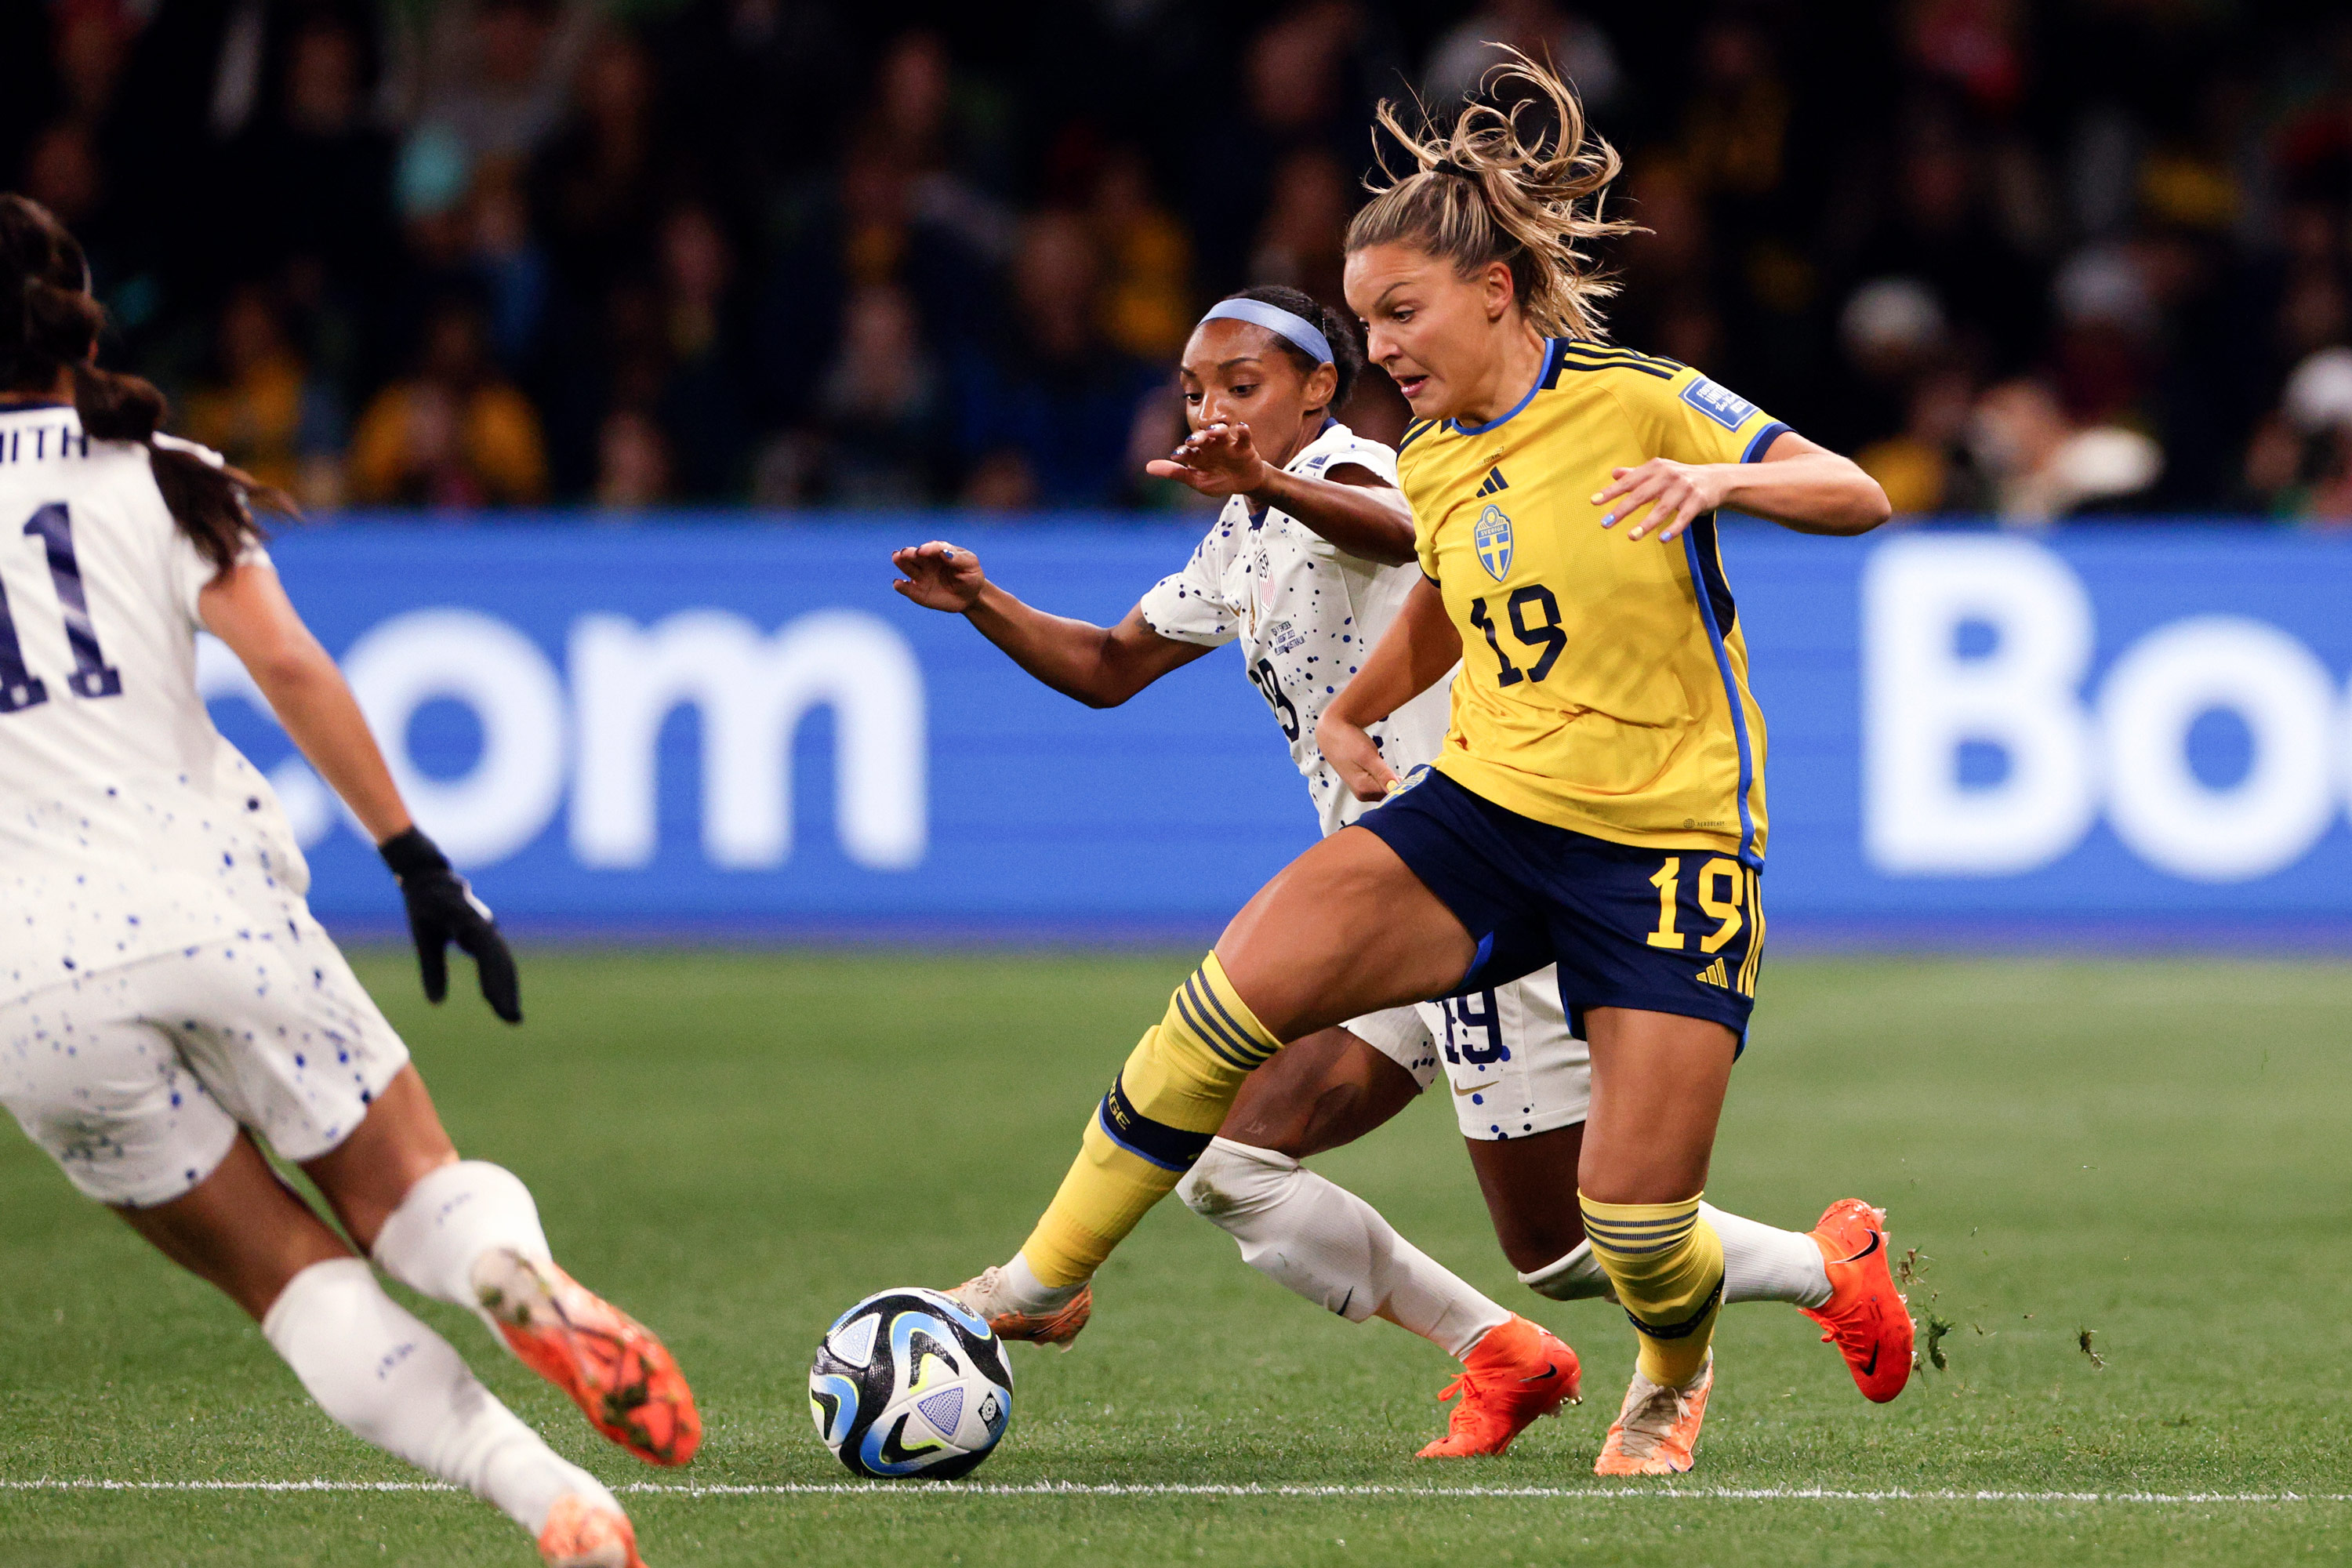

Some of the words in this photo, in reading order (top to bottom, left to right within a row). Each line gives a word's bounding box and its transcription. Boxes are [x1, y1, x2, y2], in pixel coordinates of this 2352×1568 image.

[0, 426, 89, 463] ITH
[1258, 553, 1269, 579] USA
[1480, 524, 1504, 536] SVERIGE
[1471, 583, 1567, 688] 19
[1860, 529, 2352, 884] Bo
[1646, 857, 1744, 954] 19
[1442, 987, 1503, 1065] 19
